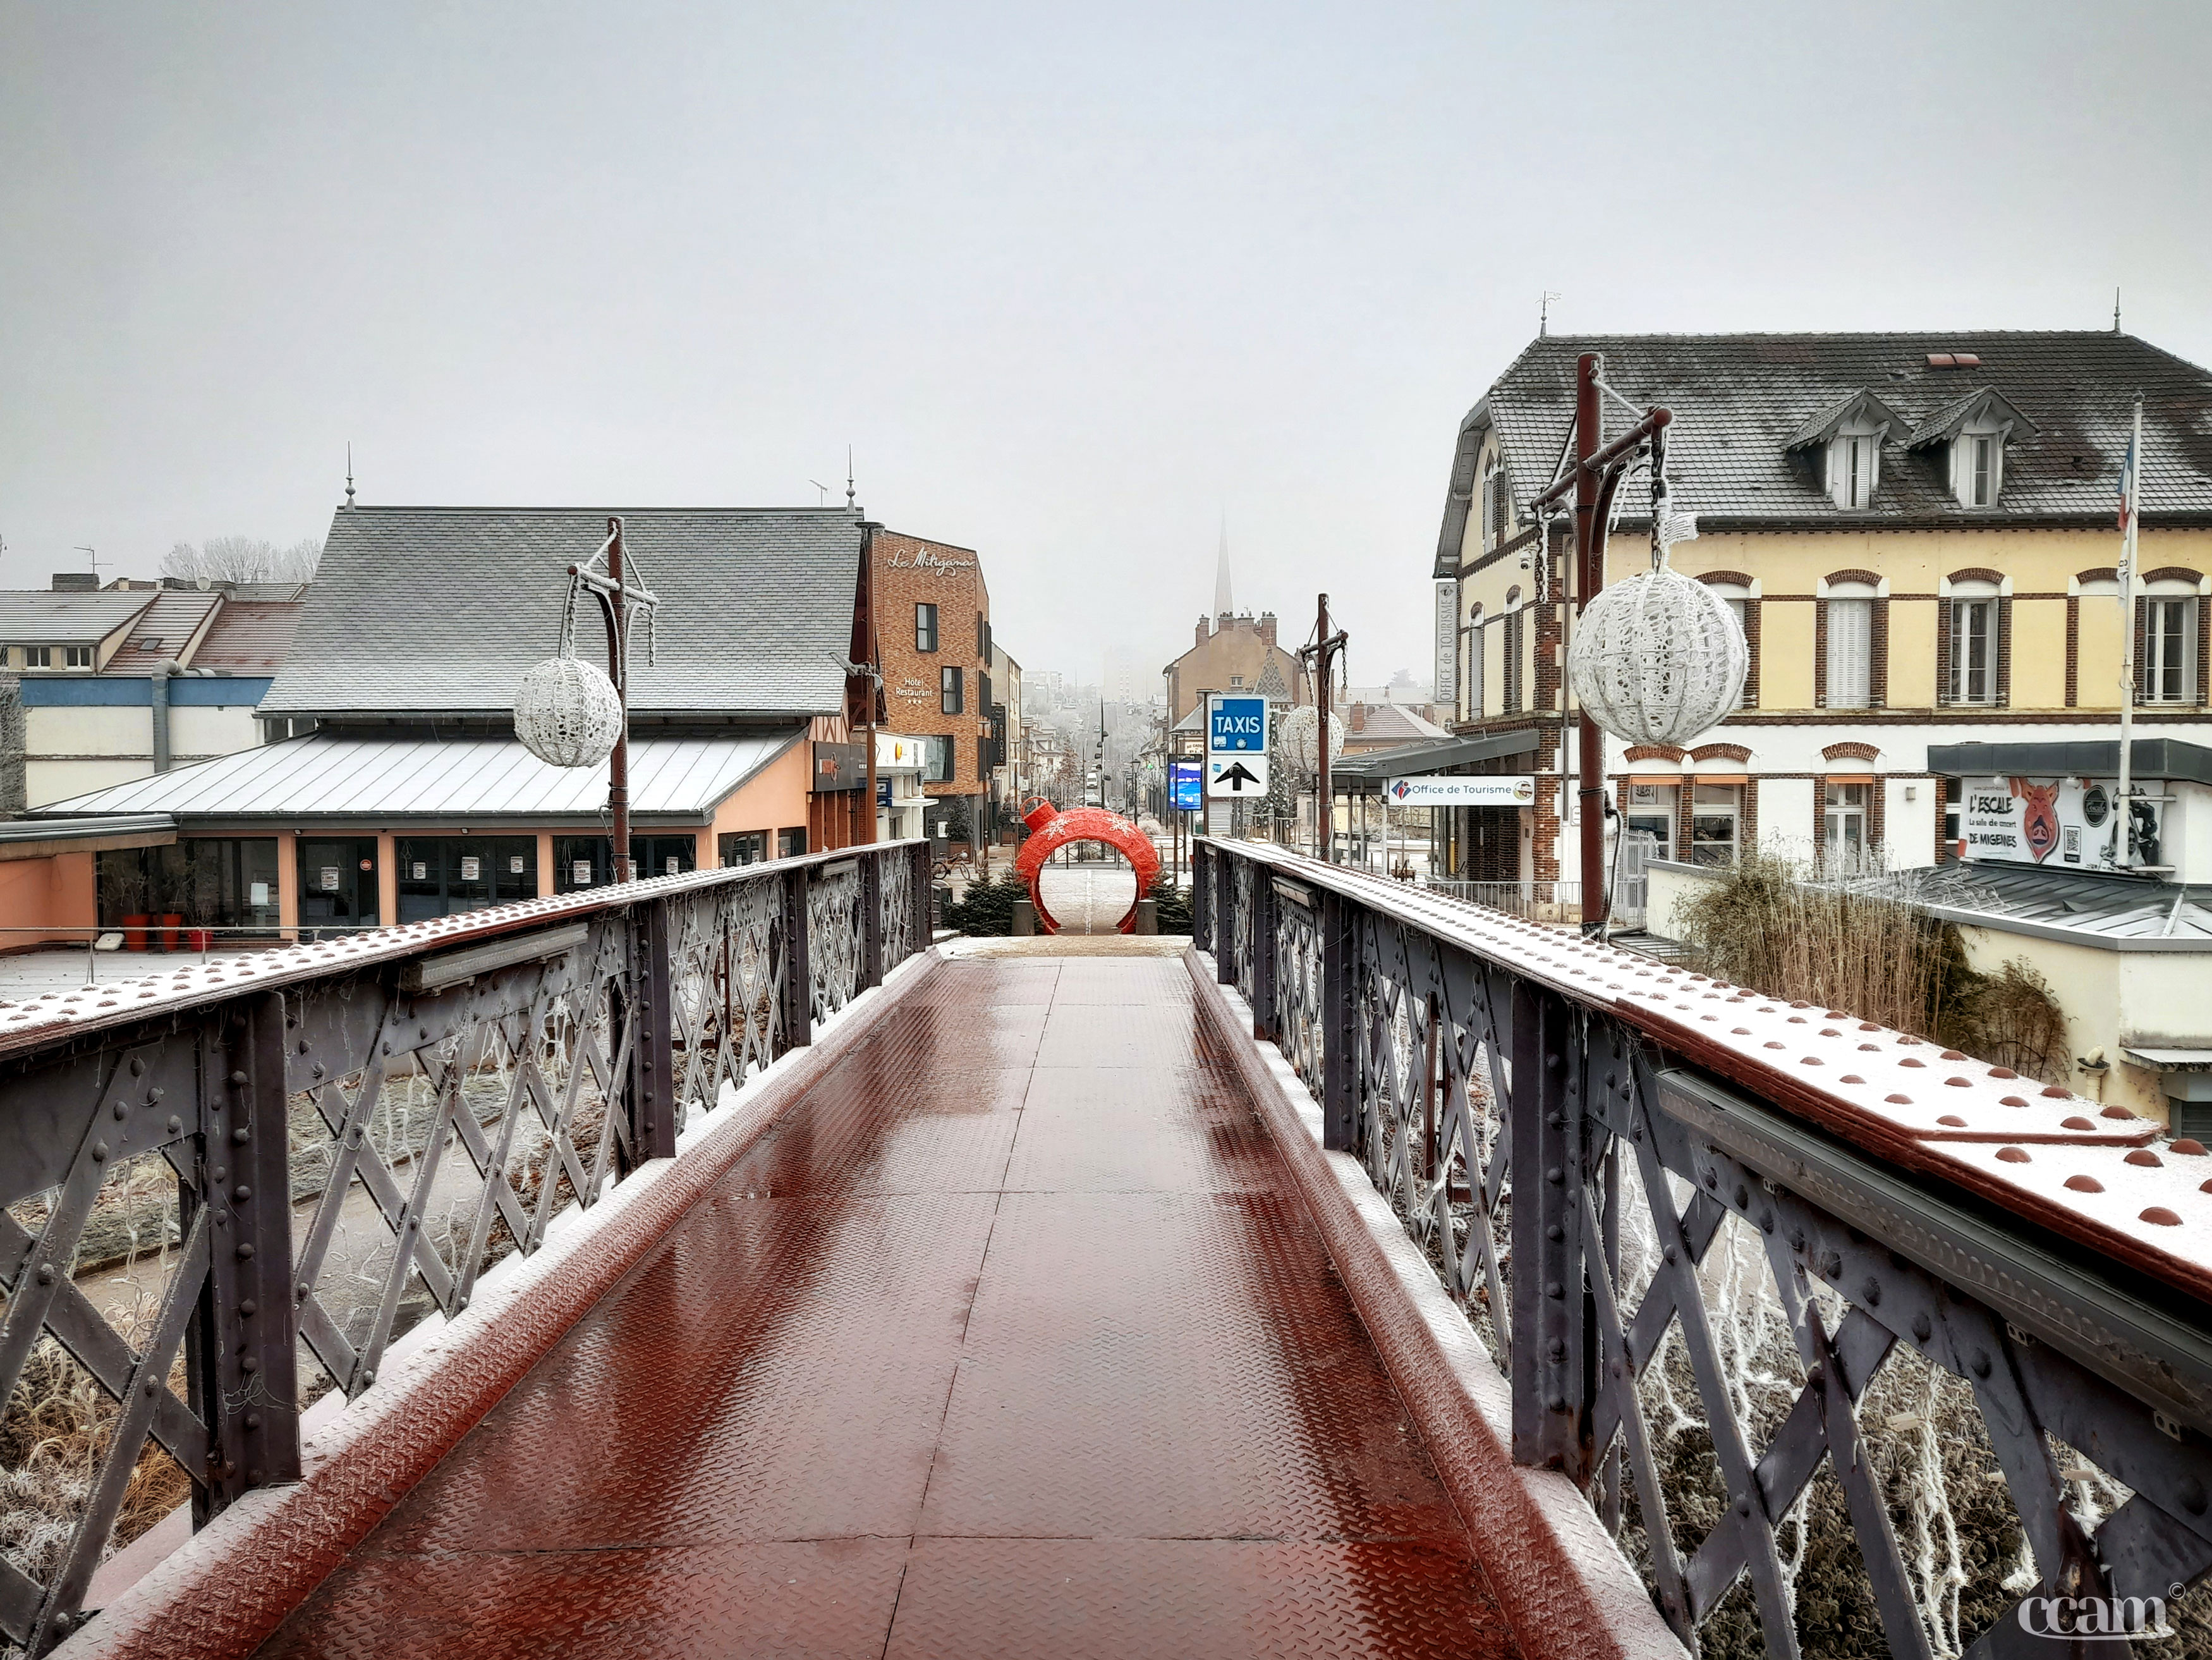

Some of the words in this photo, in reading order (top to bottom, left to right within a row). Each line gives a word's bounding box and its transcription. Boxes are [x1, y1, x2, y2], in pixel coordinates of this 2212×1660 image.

[887, 549, 909, 568] Le
[1440, 599, 1453, 649] TOURISME
[1440, 652, 1452, 664] de
[904, 677, 923, 687] Hôtel
[1440, 668, 1452, 701] OFFICE
[896, 687, 932, 697] Restaurant
[1215, 716, 1261, 733] TAXIS
[1412, 784, 1444, 794] Office
[1447, 784, 1460, 794] de
[1463, 785, 1512, 794] Tourisme
[1969, 794, 2014, 814] L'ESCALE
[1989, 819, 1998, 827] de
[1969, 833, 1979, 844] DE
